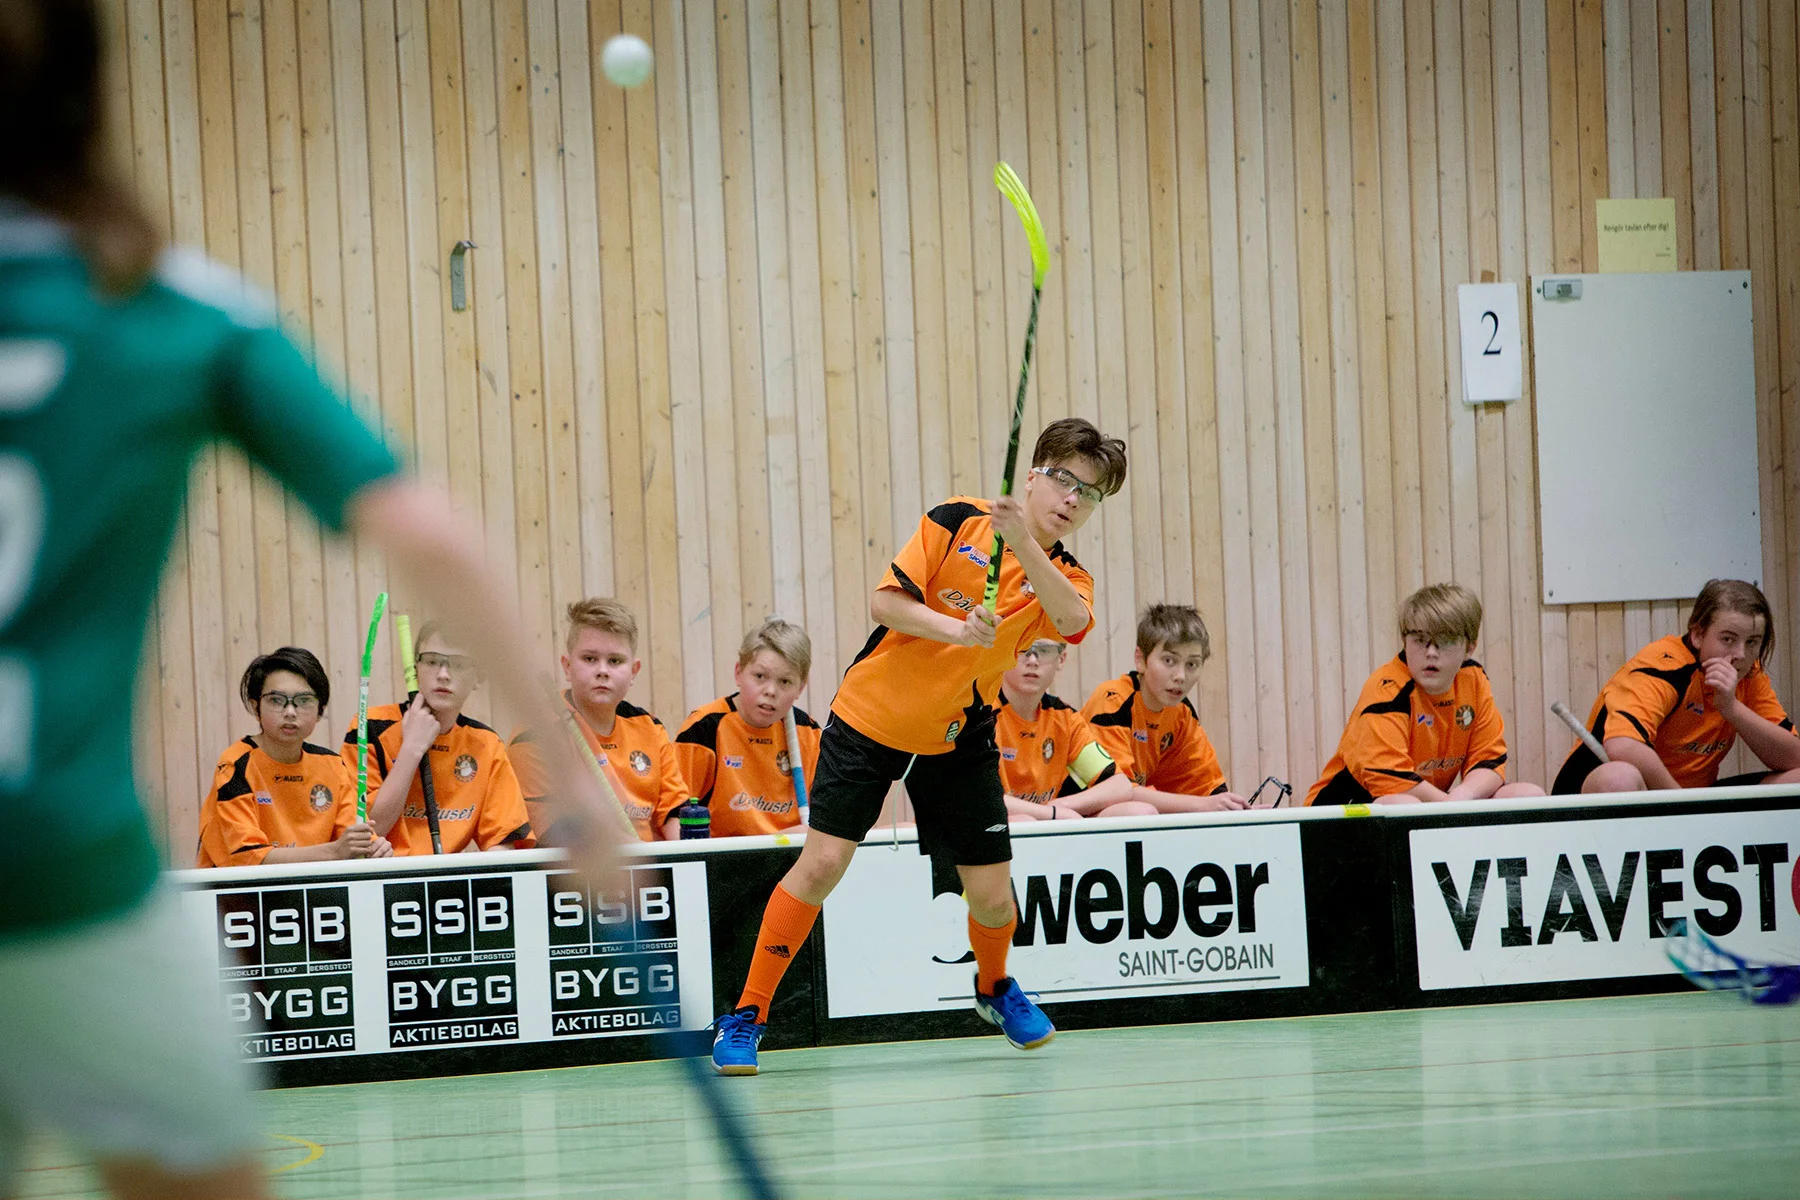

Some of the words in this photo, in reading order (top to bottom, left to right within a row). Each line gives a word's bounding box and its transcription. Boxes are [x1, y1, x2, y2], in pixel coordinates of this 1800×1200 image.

[1481, 311, 1502, 356] 2
[553, 885, 671, 928] SSB
[1010, 840, 1270, 947] weber
[223, 905, 346, 949] SSB
[390, 895, 510, 938] SSB
[309, 962, 352, 973] BERGSTEDT
[388, 958, 427, 967] SANDKLEF
[474, 952, 516, 962] BERGSTEDT
[551, 947, 589, 956] SANDKLEF
[1117, 943, 1275, 979] SAINT-GOBAIN
[392, 974, 512, 1012] BYGG
[554, 963, 674, 1000] BYGG
[226, 985, 349, 1023] BYGG
[554, 1010, 679, 1032] AKTIEBOLAG
[238, 1033, 354, 1055] KTIEBOLAG
[391, 1021, 517, 1044] AKTIEBOLAG
